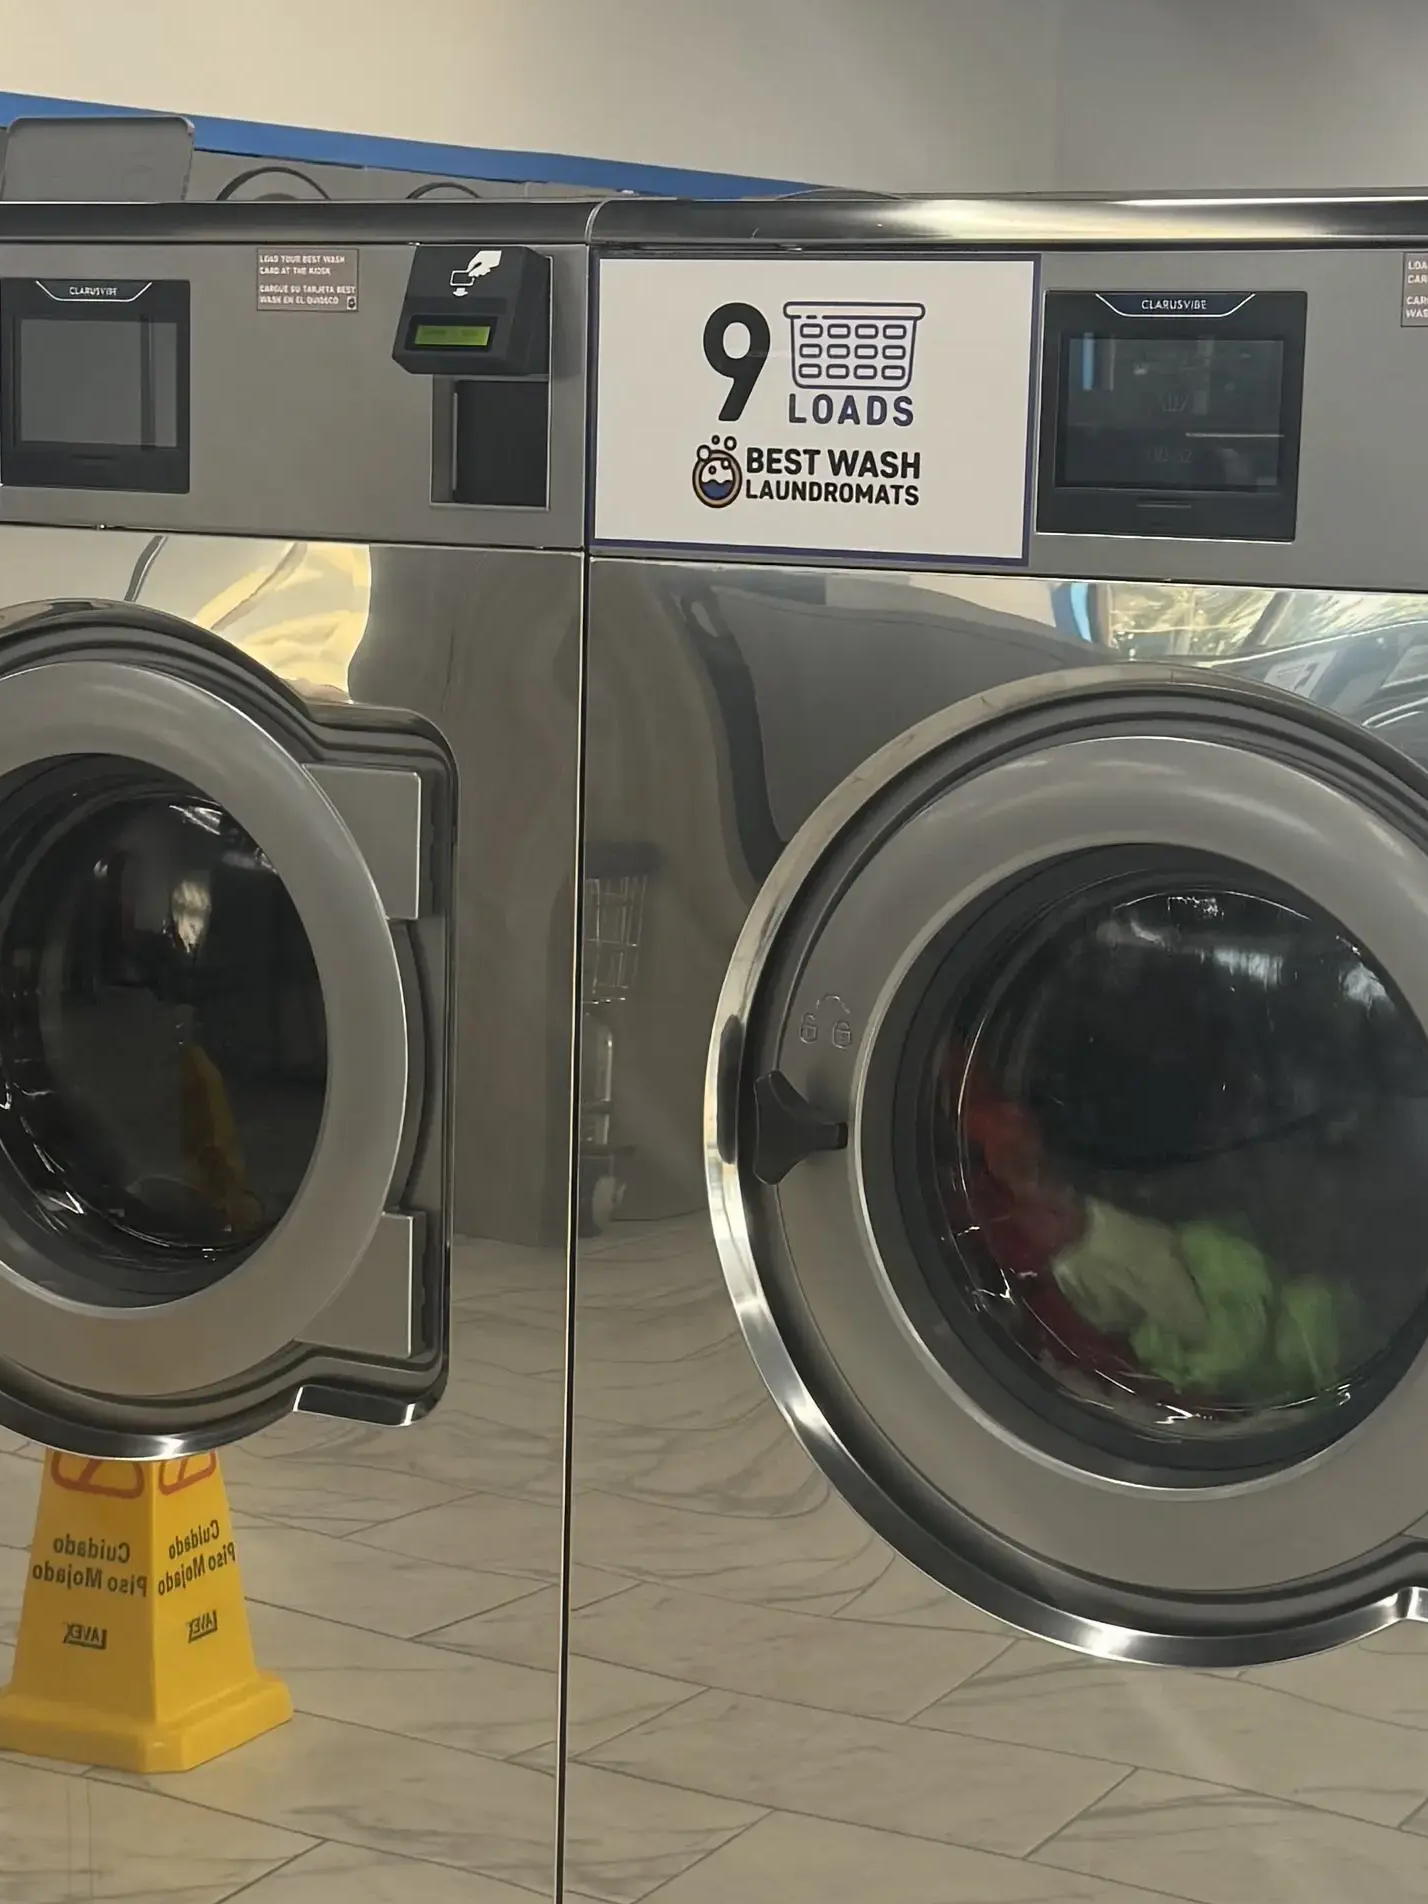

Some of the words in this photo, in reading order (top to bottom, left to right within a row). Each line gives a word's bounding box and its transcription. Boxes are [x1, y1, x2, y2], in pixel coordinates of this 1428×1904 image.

[1141, 299, 1207, 310] CLARUSVIBE
[703, 302, 771, 422] 9
[788, 393, 914, 427] LOADS
[746, 447, 821, 476] BEST
[827, 448, 921, 479] WASH
[745, 479, 920, 506] LAUNDROMATS
